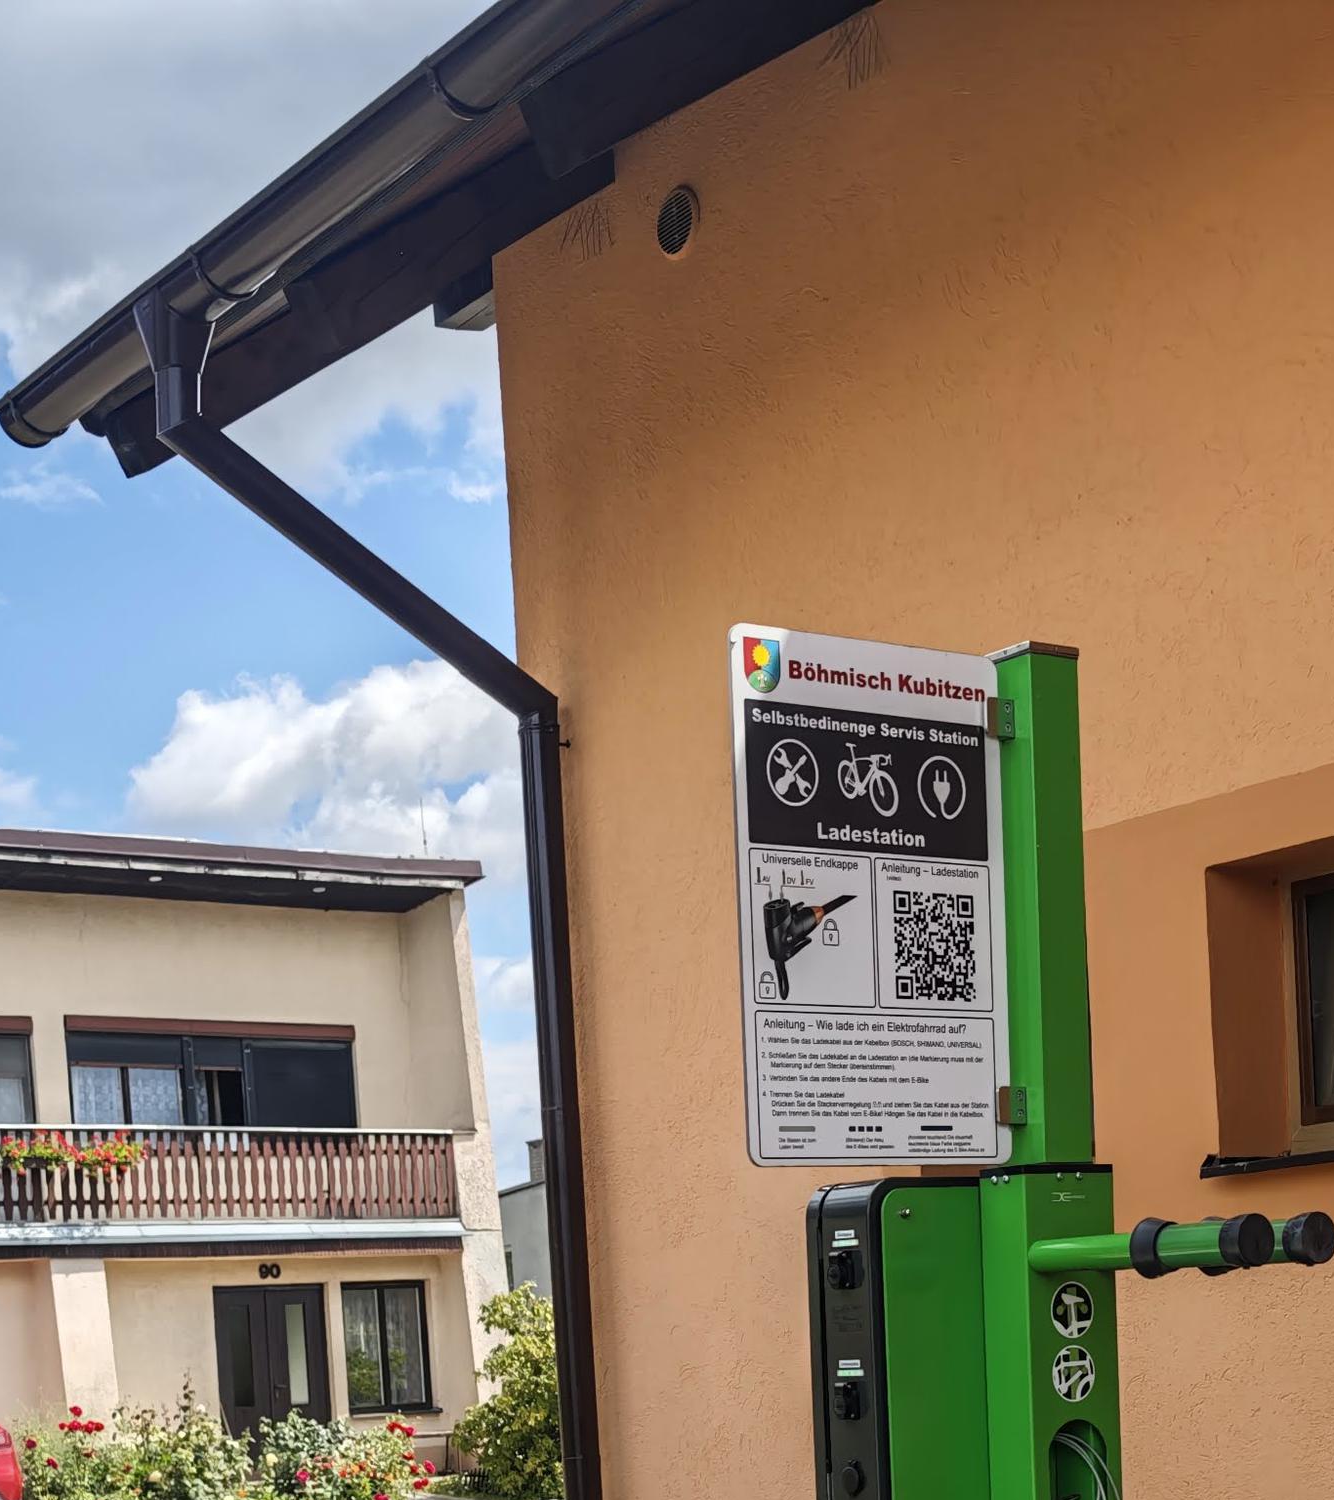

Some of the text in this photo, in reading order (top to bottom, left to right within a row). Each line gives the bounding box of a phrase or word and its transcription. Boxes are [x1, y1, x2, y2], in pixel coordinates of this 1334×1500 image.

[788, 660, 985, 702] Böhmisch Kubitzen
[752, 707, 979, 747] Selbstbedinenge Servis Station
[817, 822, 925, 848] Ladestation
[762, 853, 858, 871] Universelle Endkappe
[881, 862, 921, 876] Anleitung
[931, 866, 978, 878] Ladestation
[764, 1018, 805, 1031] Anleitung
[816, 1020, 833, 1030] Wie
[836, 1020, 854, 1031] lade
[857, 1021, 869, 1031] ich
[871, 1022, 885, 1032] ein
[887, 1022, 946, 1033] Elektrofahrrad
[949, 1024, 966, 1034] auf?
[259, 1263, 281, 1279] 90
